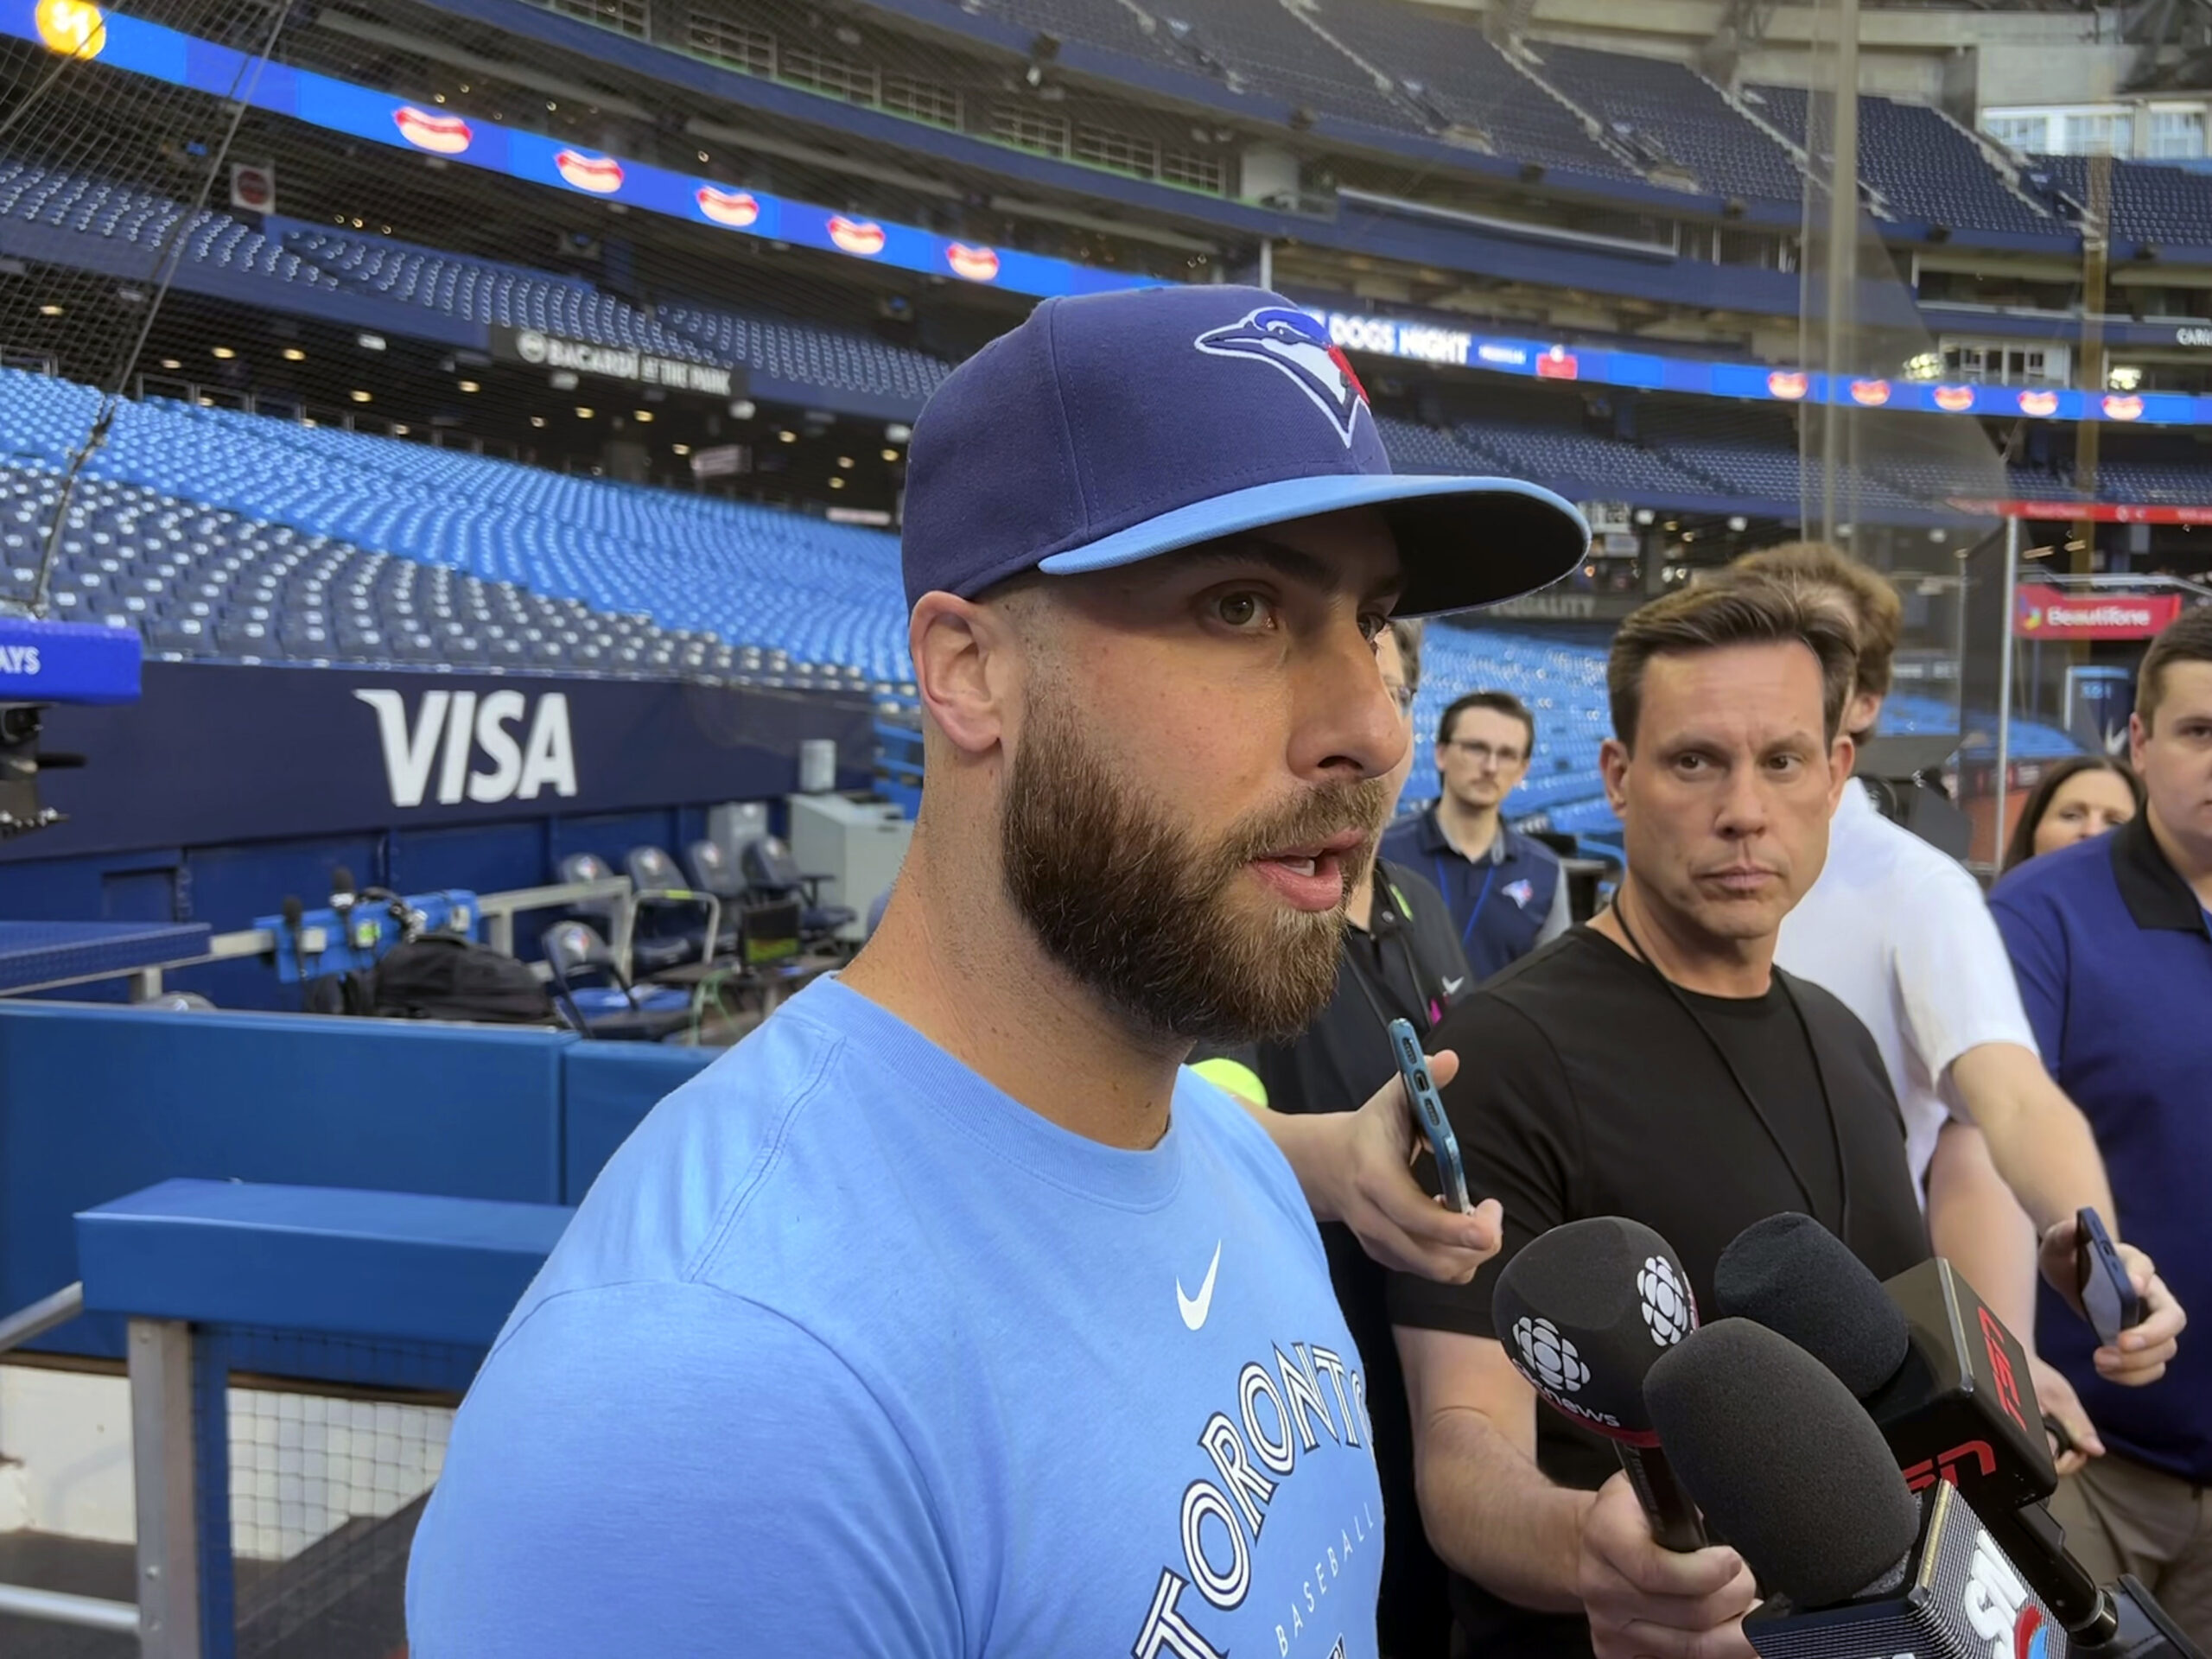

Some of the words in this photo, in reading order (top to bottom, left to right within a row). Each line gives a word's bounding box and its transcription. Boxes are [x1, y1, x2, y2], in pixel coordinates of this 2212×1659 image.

[1329, 311, 1395, 356] DOGS
[1397, 323, 1471, 365] NIGHT
[353, 689, 577, 807] VISA
[1275, 1503, 1373, 1658] BASEBALL
